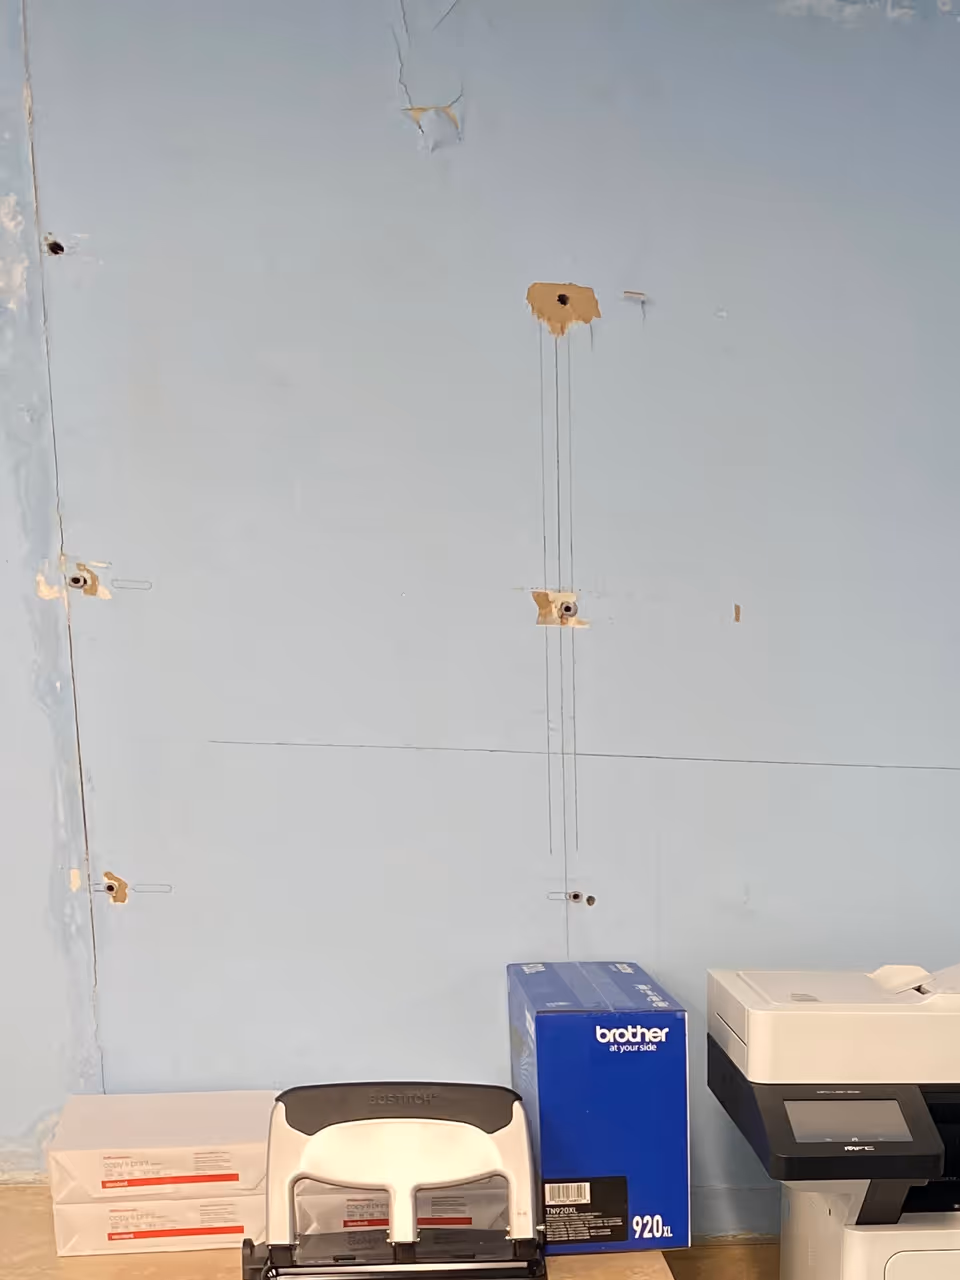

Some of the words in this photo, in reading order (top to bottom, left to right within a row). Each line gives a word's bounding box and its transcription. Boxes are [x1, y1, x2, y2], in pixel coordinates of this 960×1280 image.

[595, 1025, 669, 1043] brother
[609, 1044, 618, 1052] at
[619, 1044, 639, 1053] your
[639, 1043, 657, 1051] side
[546, 1207, 578, 1215] TN920XL
